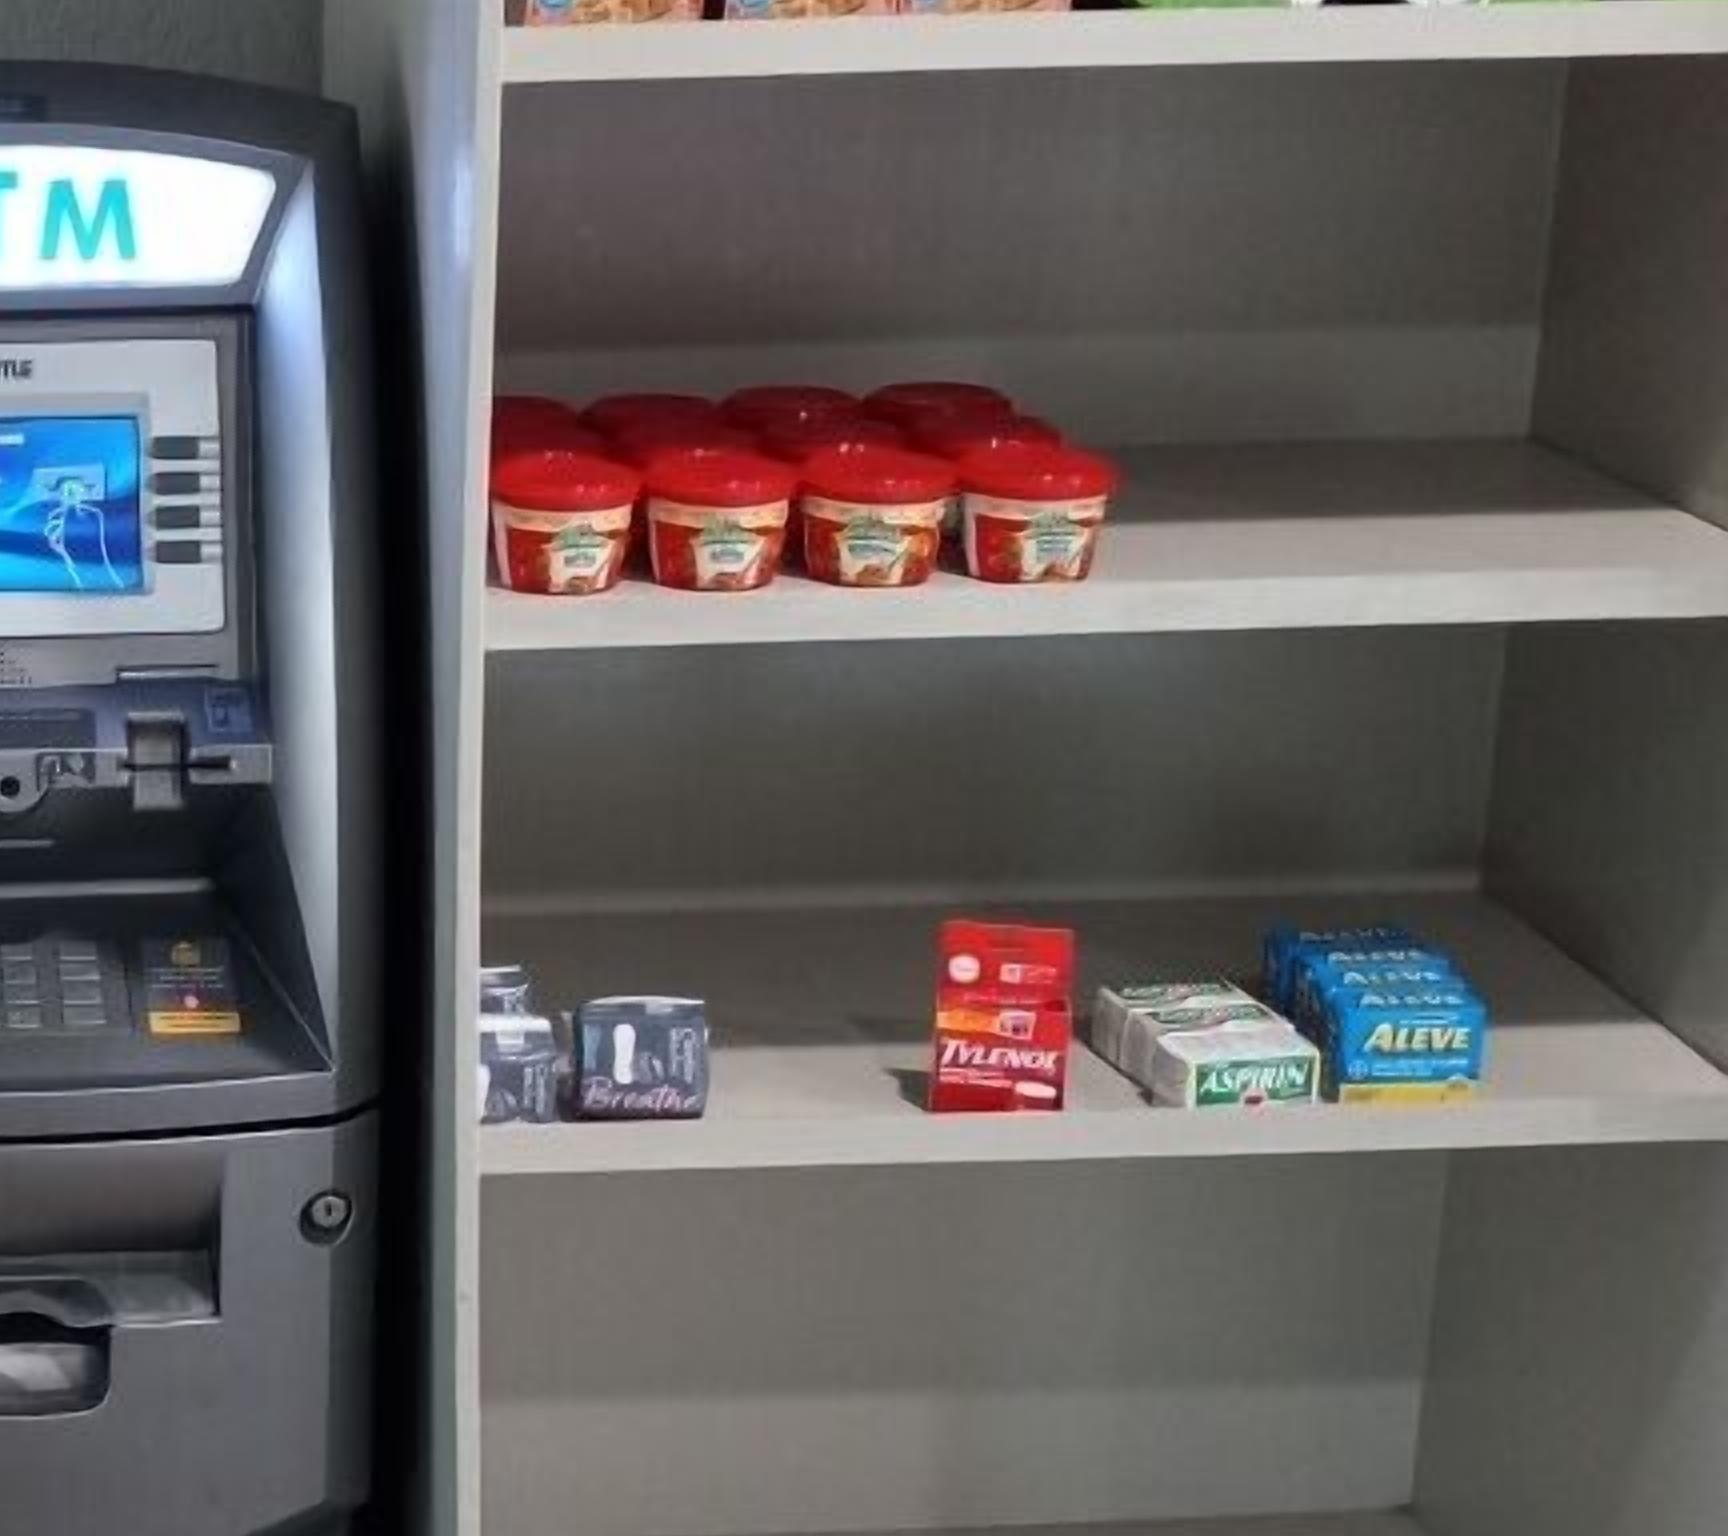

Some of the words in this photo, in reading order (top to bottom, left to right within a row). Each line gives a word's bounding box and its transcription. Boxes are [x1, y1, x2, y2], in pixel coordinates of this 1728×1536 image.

[1362, 1021, 1473, 1053] ALEVE
[939, 1038, 1060, 1072] TYLENOL
[1199, 1060, 1310, 1095] ASPIRIN
